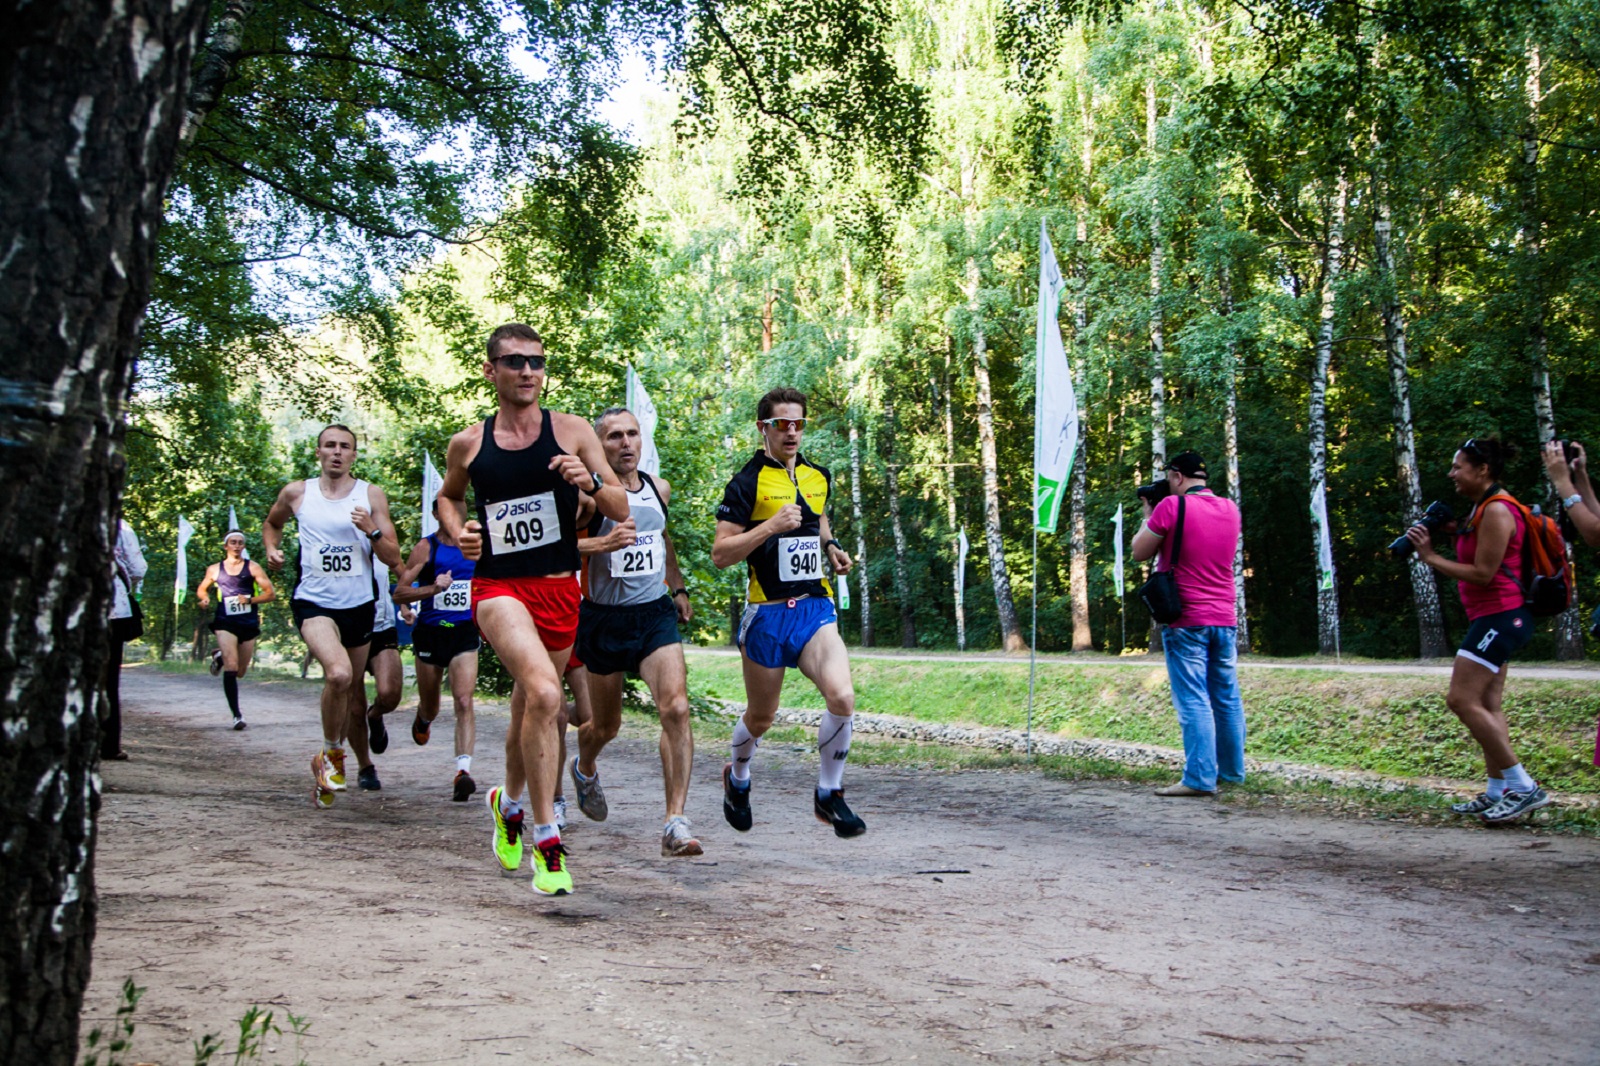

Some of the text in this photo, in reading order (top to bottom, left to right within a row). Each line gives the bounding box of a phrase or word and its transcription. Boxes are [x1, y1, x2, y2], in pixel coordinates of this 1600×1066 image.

[510, 500, 542, 516] asics
[504, 518, 544, 547] 409
[330, 545, 354, 553] asics
[799, 541, 818, 551] asics
[322, 555, 352, 572] 503
[623, 549, 653, 572] 221
[791, 552, 817, 576] 940
[443, 592, 467, 607] 635
[230, 603, 246, 613] 611
